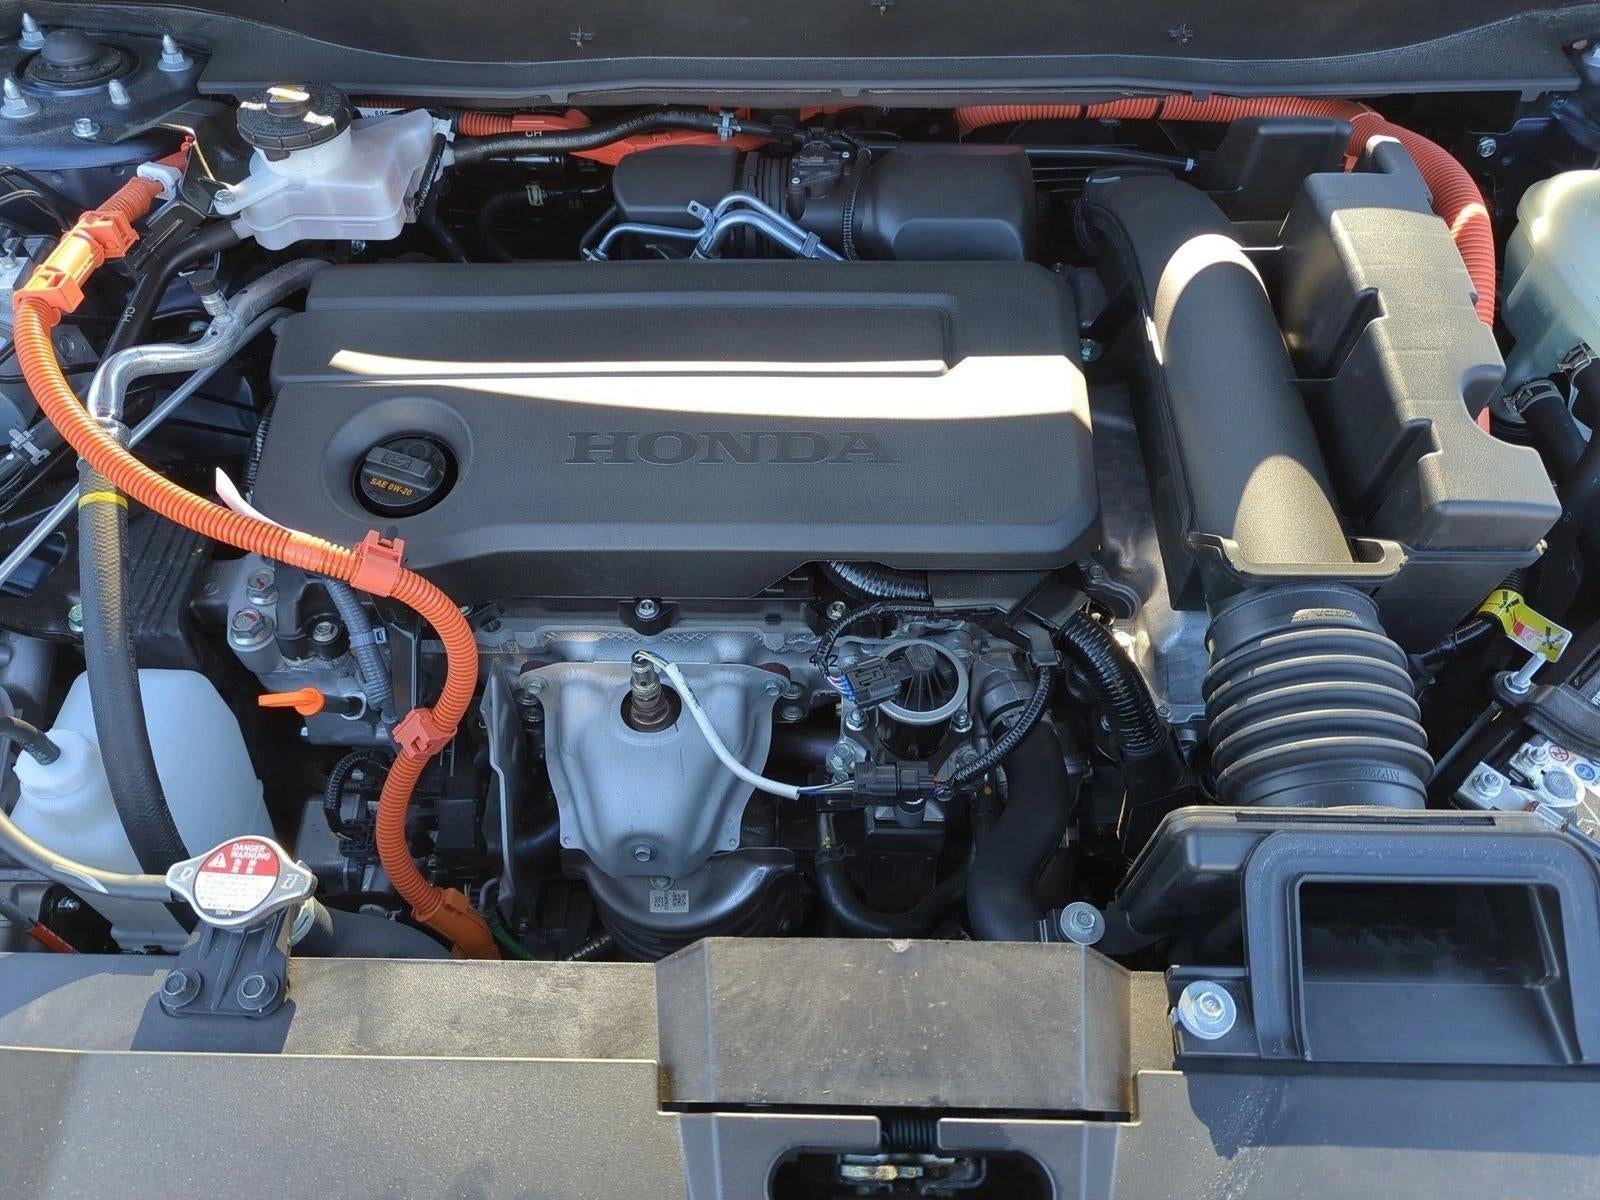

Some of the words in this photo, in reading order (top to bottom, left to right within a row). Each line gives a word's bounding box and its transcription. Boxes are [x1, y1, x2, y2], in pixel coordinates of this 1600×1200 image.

[564, 430, 901, 465] HONDA
[370, 477, 387, 489] SAE
[388, 483, 413, 496] 0W-20
[232, 843, 266, 853] DANGER
